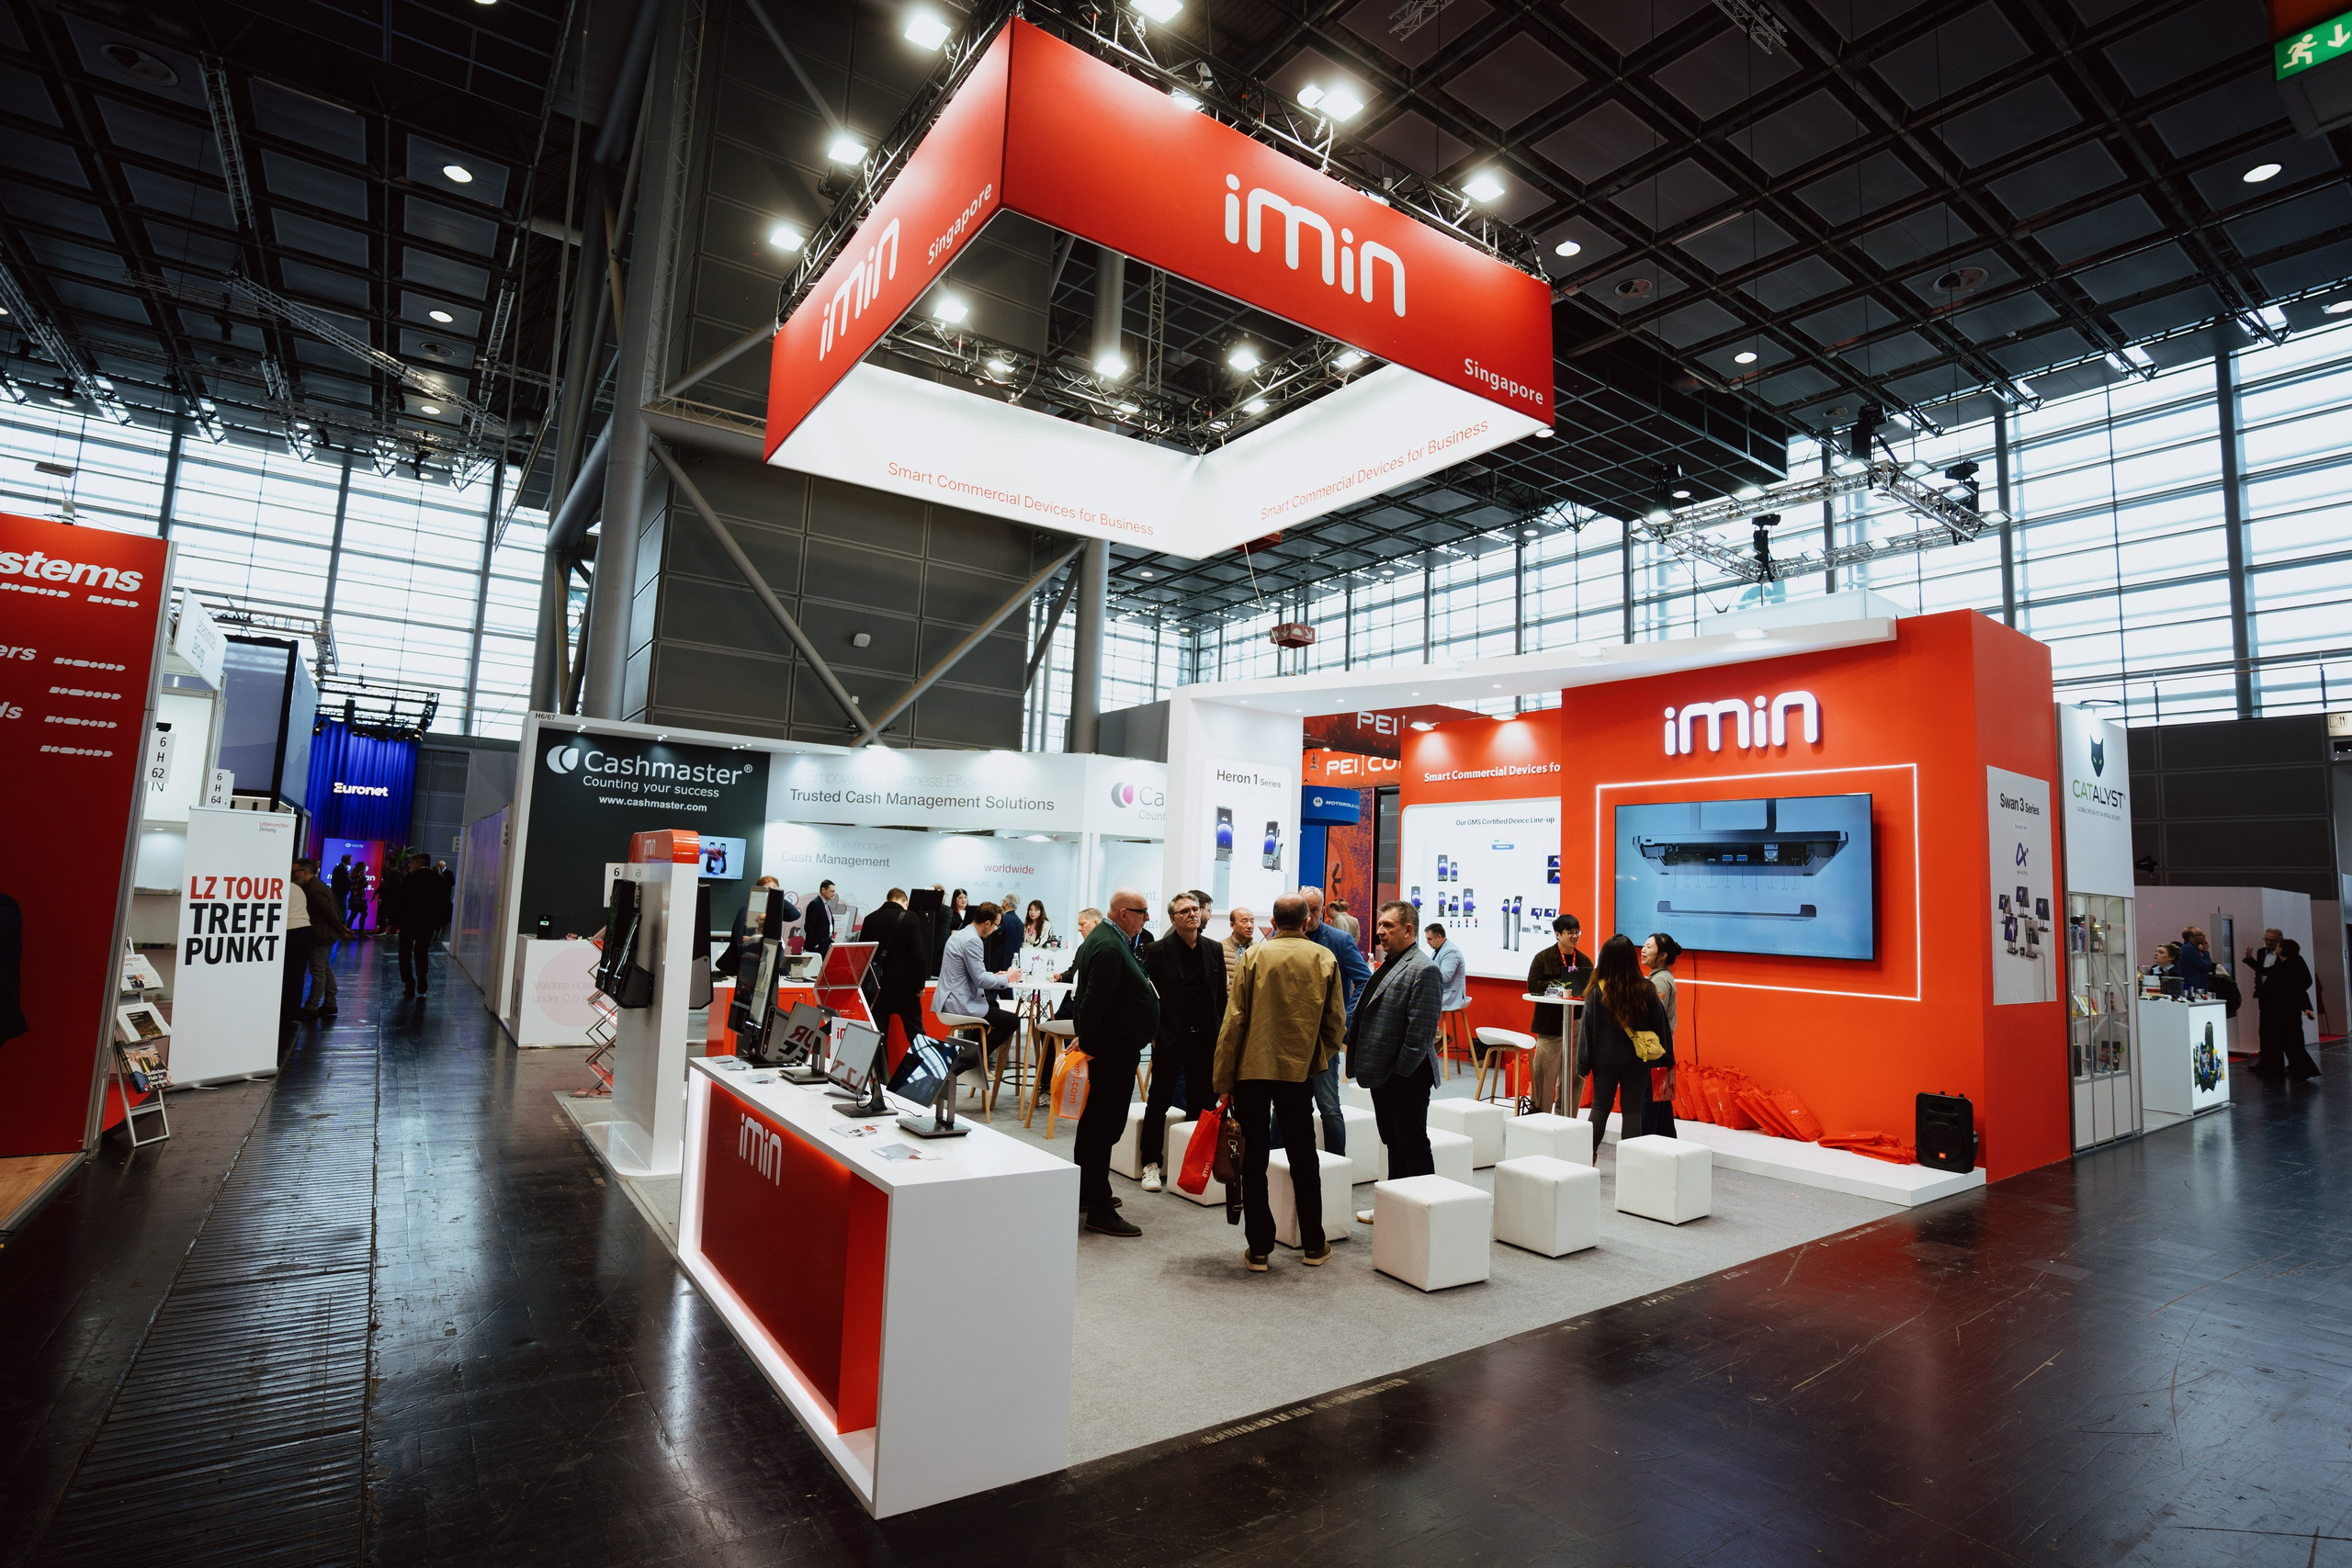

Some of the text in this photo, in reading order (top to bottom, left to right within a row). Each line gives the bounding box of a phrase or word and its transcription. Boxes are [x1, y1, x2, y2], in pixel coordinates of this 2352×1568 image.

[928, 183, 992, 265] Singapore
[1225, 174, 1406, 317] imin
[820, 218, 899, 361] imin
[1464, 357, 1544, 405] Singapore
[1261, 420, 1488, 521] Smart Commercial Devices for Business
[888, 462, 1154, 536] Smart Commercial Devices for Business
[1664, 690, 1819, 756] imin
[160, 737, 167, 747] 6
[156, 752, 165, 762] H
[152, 768, 164, 779] 62
[217, 773, 222, 781] 6
[1216, 769, 1282, 788] Heron 1 Series
[1424, 771, 1451, 783] Smart
[1453, 766, 1507, 781] Commercial
[1509, 763, 1547, 777] Devices
[333, 782, 389, 797] Euronet
[582, 775, 719, 798] Counting your success
[2072, 779, 2124, 809] CATALYST
[210, 795, 221, 805] 64
[599, 795, 707, 813] www.cashmaster.com
[790, 788, 1055, 811] Trusted Cash Management Solutions
[2000, 793, 2040, 816] Swan 3 Series
[1531, 816, 1555, 824] Line-up
[781, 851, 890, 869] Cash Management
[984, 863, 1035, 874] worldwide
[189, 875, 284, 900] LZ TOUR
[188, 902, 282, 935] TREFF
[185, 935, 279, 965] PUNKT
[533, 980, 570, 990] Validate
[532, 993, 560, 1003] under
[562, 993, 580, 1003] 0.5
[739, 1112, 782, 1187] imin
